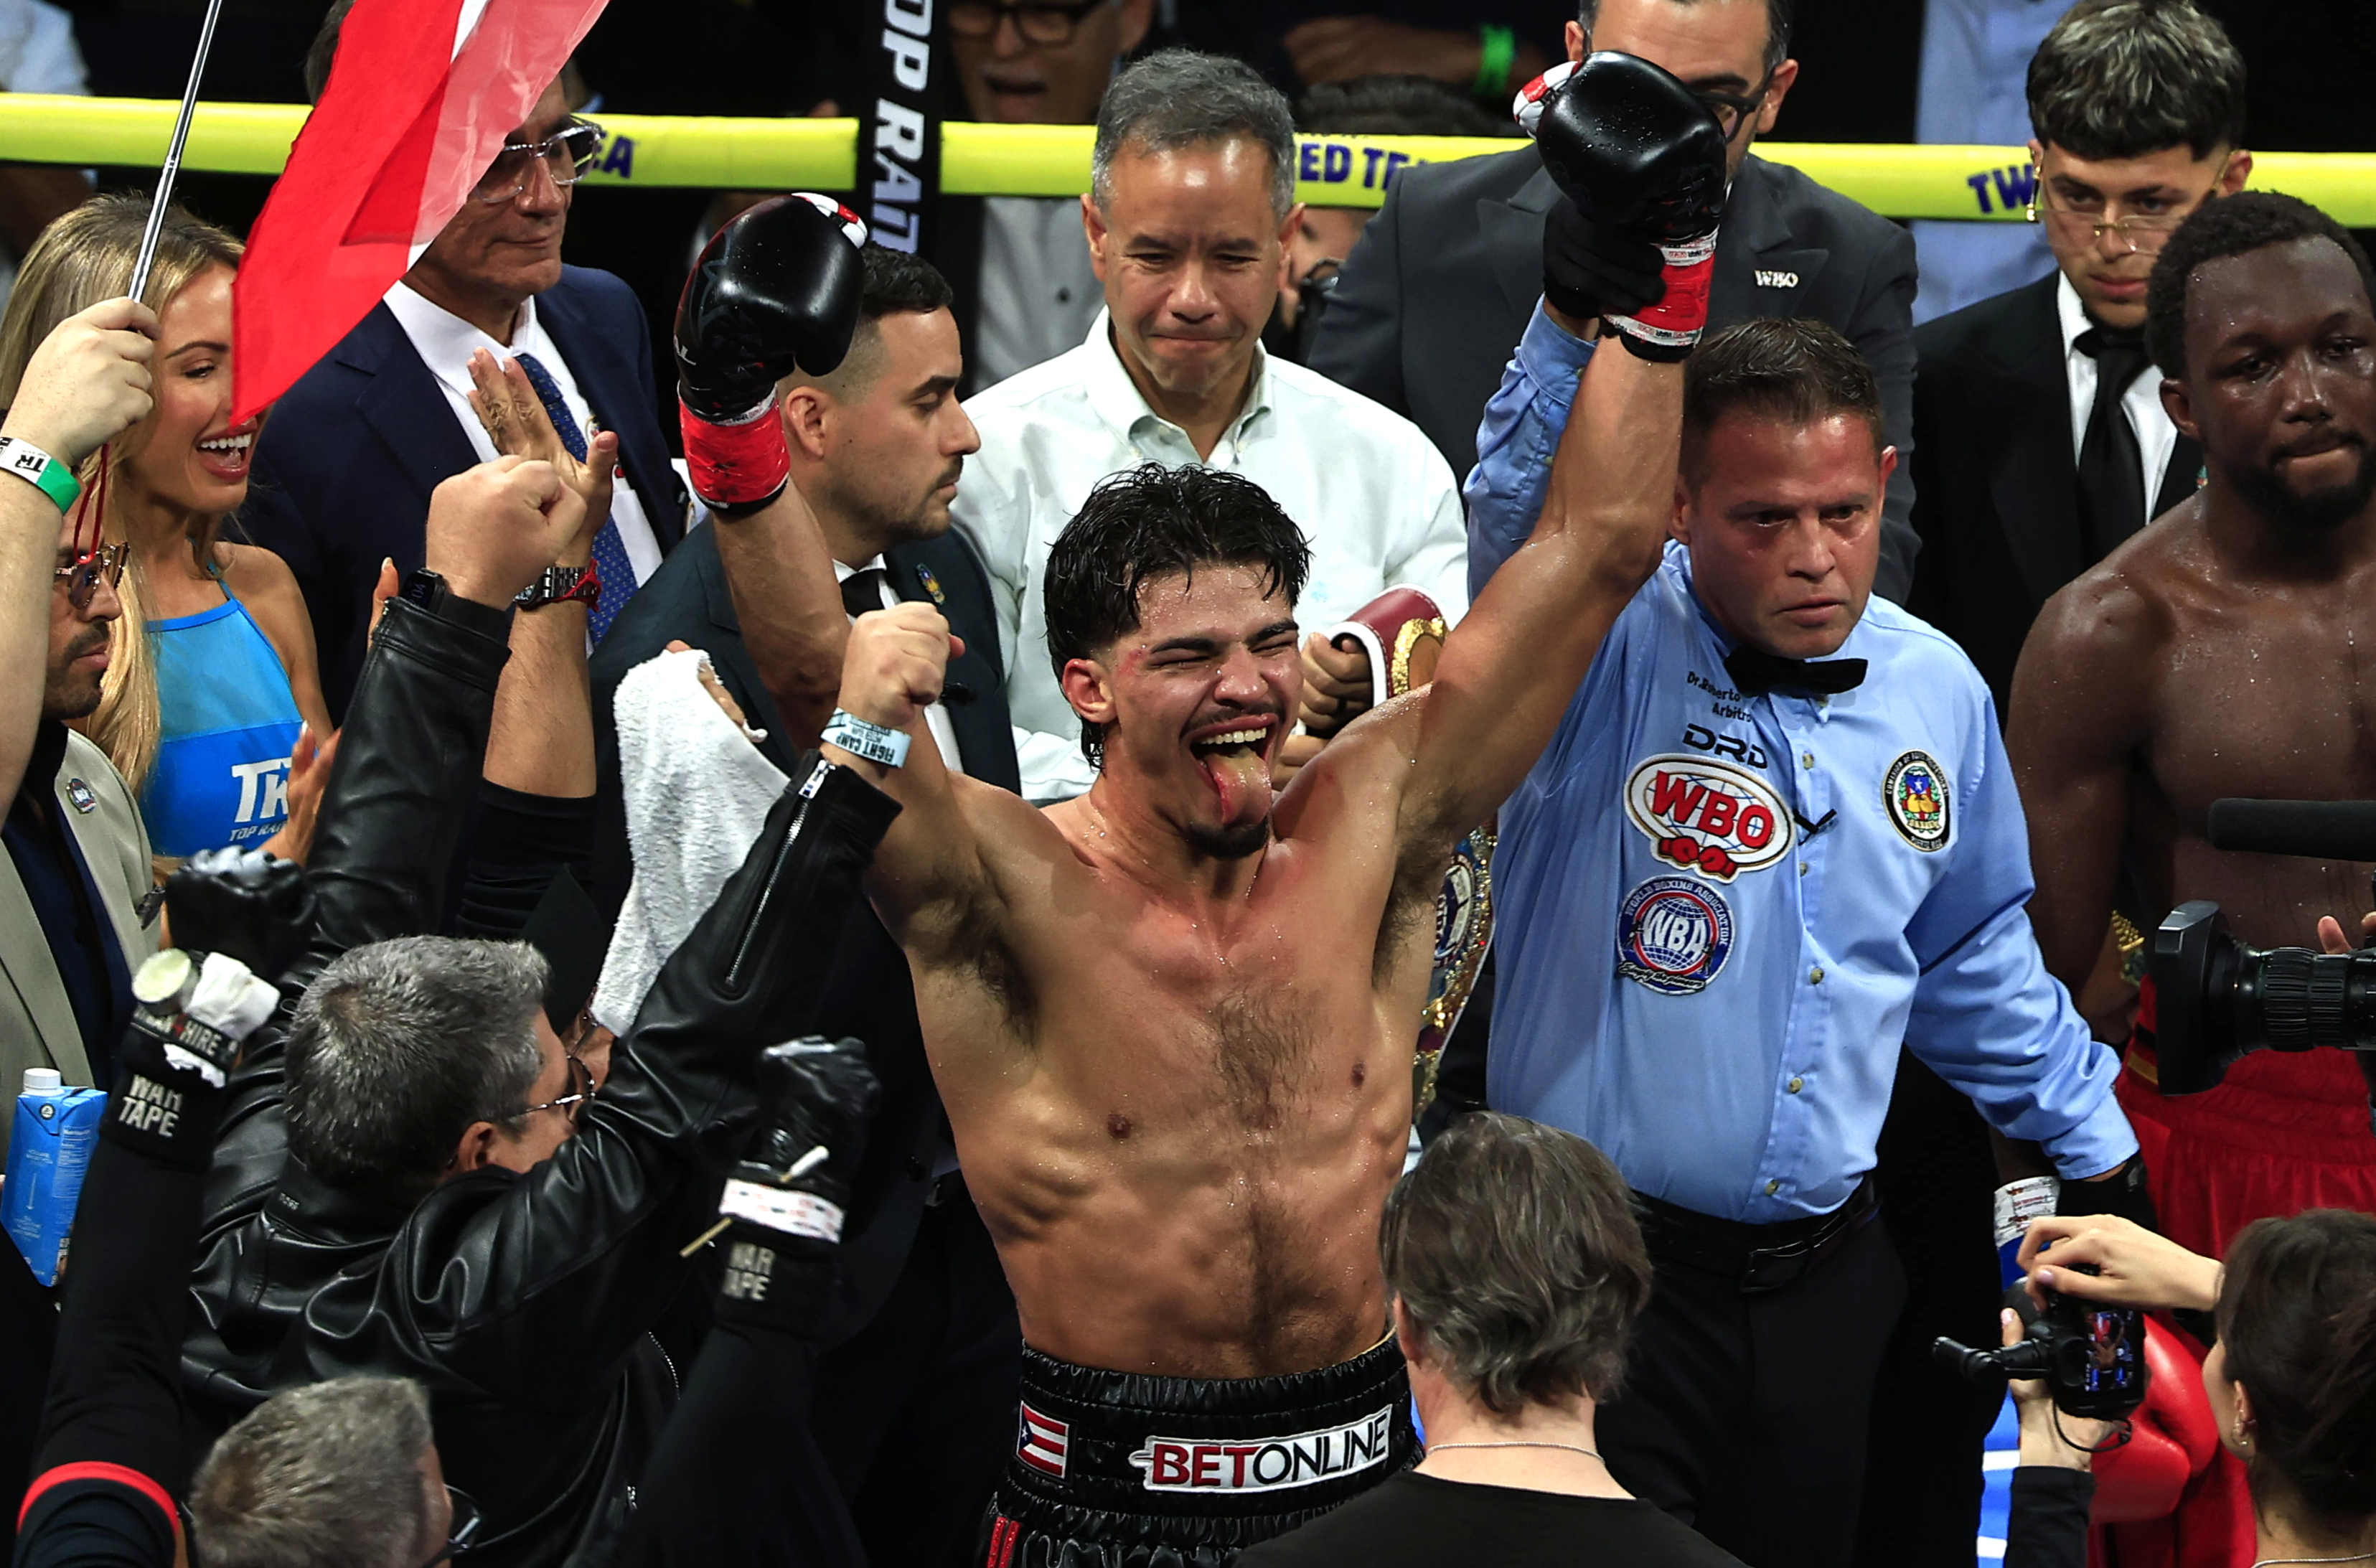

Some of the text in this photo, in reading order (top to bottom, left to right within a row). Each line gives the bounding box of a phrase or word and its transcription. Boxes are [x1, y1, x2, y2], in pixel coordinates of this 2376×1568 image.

[881, 0, 933, 91] OP
[836, 732, 863, 752] CAMP
[862, 741, 896, 762] FIGHT
[1682, 723, 1768, 769] DRD
[229, 826, 258, 842] TOP
[1653, 770, 1774, 849] WBO
[1625, 881, 1729, 947] WORLD BOXING ASSOCIATION
[1643, 903, 1707, 962] WBA
[118, 1096, 179, 1137] TAPE
[1152, 1413, 1388, 1487] BETONLINE
